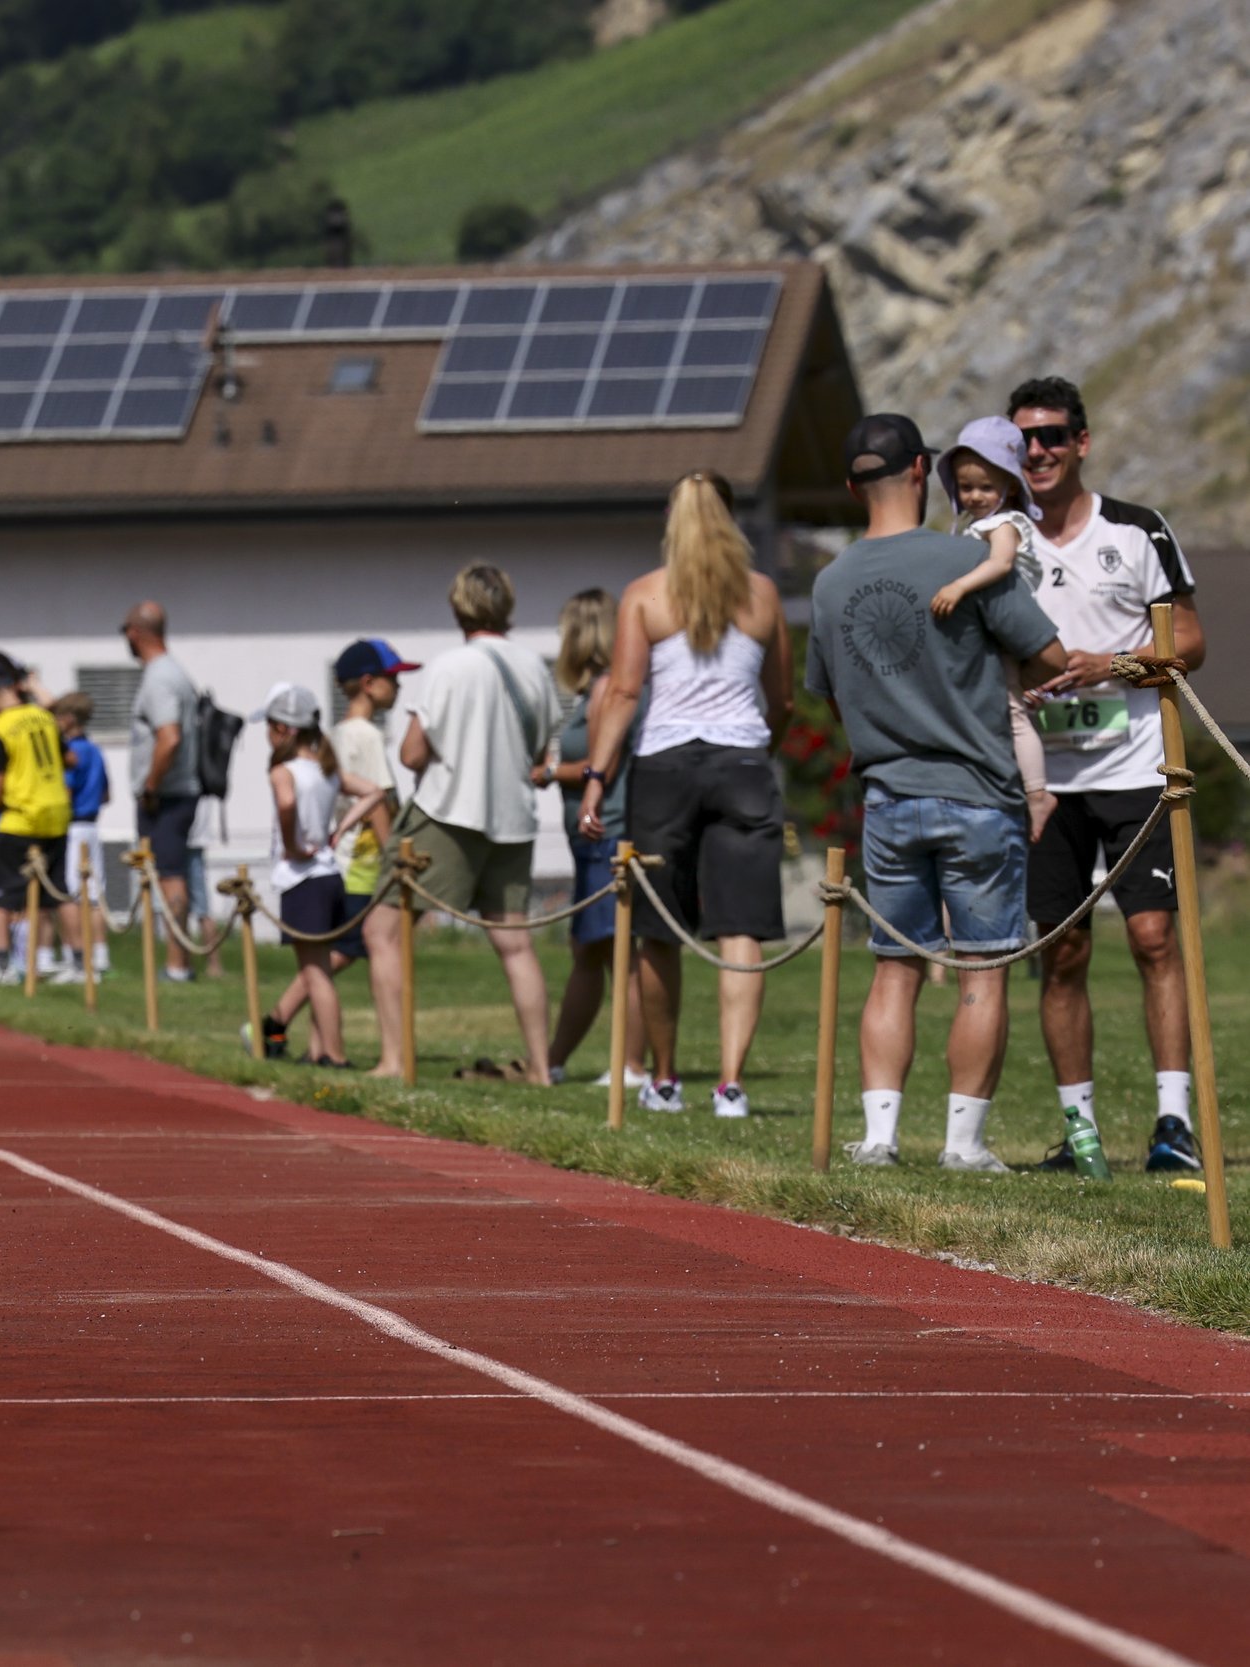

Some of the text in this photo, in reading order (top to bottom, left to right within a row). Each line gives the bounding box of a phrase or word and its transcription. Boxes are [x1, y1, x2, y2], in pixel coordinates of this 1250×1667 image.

[1051, 567, 1066, 588] 2
[843, 579, 919, 619] patagonia
[1064, 701, 1100, 729] 76
[29, 728, 54, 769] 11
